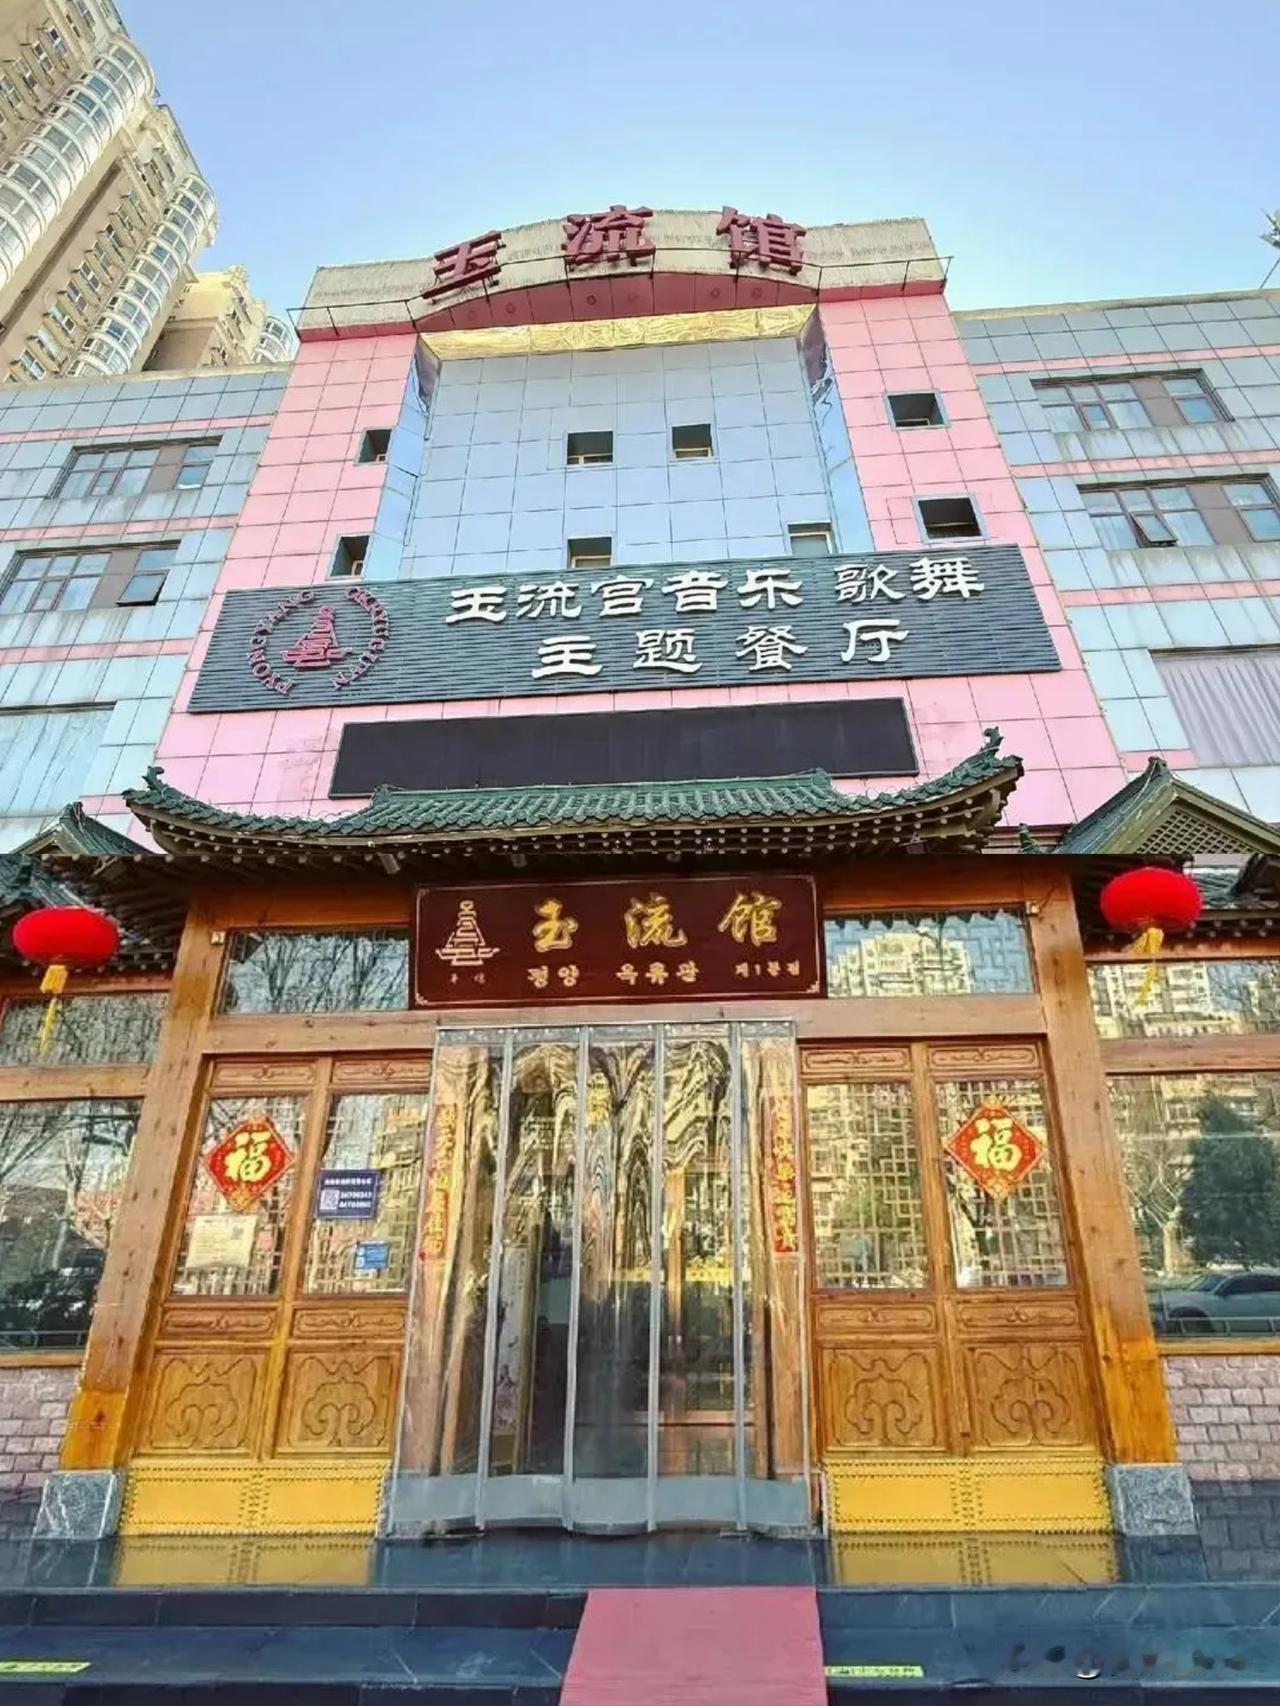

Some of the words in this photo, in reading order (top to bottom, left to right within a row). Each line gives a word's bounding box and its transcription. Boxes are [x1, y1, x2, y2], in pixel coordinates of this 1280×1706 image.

[421, 204, 806, 299] 玉流馆
[531, 619, 910, 679] 主题餐厅
[532, 892, 783, 953] 玉流馆
[527, 965, 580, 988] 평양
[224, 1131, 272, 1183] 福
[970, 1117, 1023, 1171] 福
